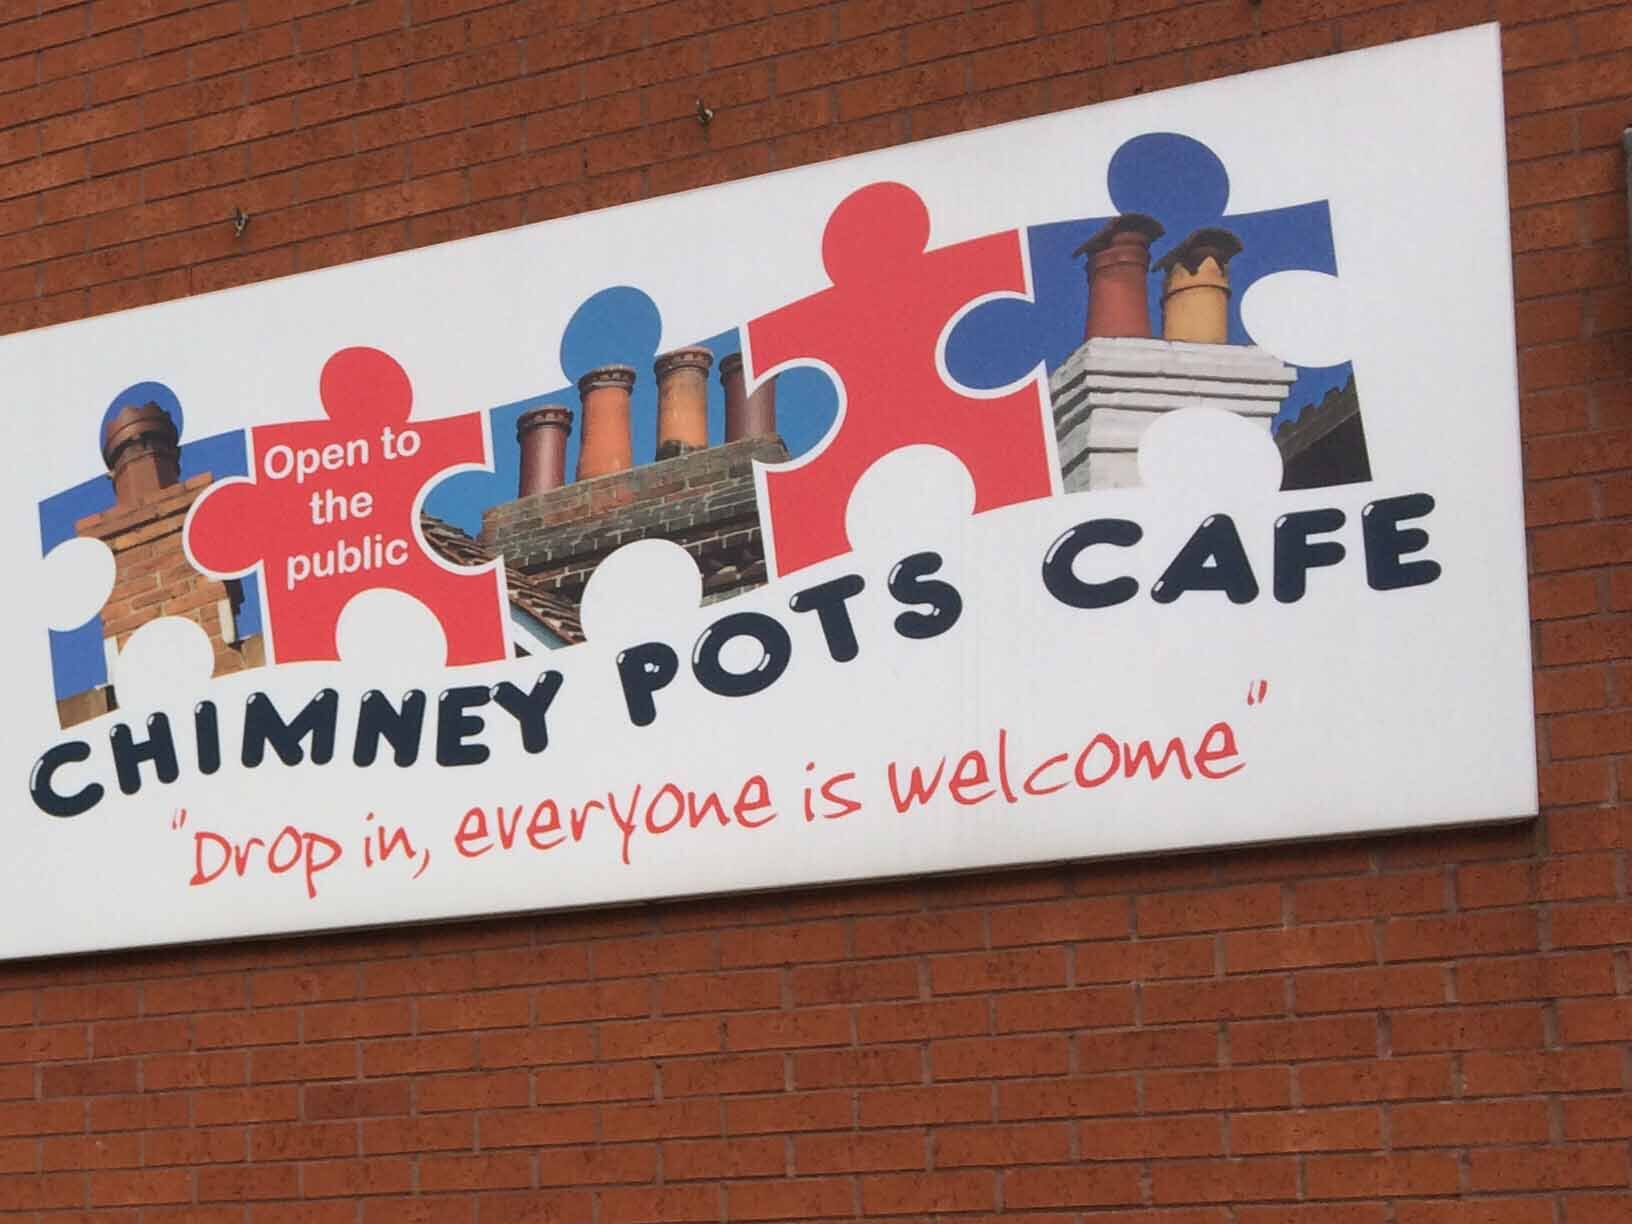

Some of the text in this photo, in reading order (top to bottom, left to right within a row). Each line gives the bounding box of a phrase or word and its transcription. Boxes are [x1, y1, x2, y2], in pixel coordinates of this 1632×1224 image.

[264, 427, 421, 484] Open to
[310, 490, 373, 525] the
[286, 535, 409, 589] public
[30, 492, 1442, 817] CHIMNEY POTS CAFE
[364, 813, 429, 878] in,
[454, 763, 776, 865] everyone
[804, 763, 861, 821] is
